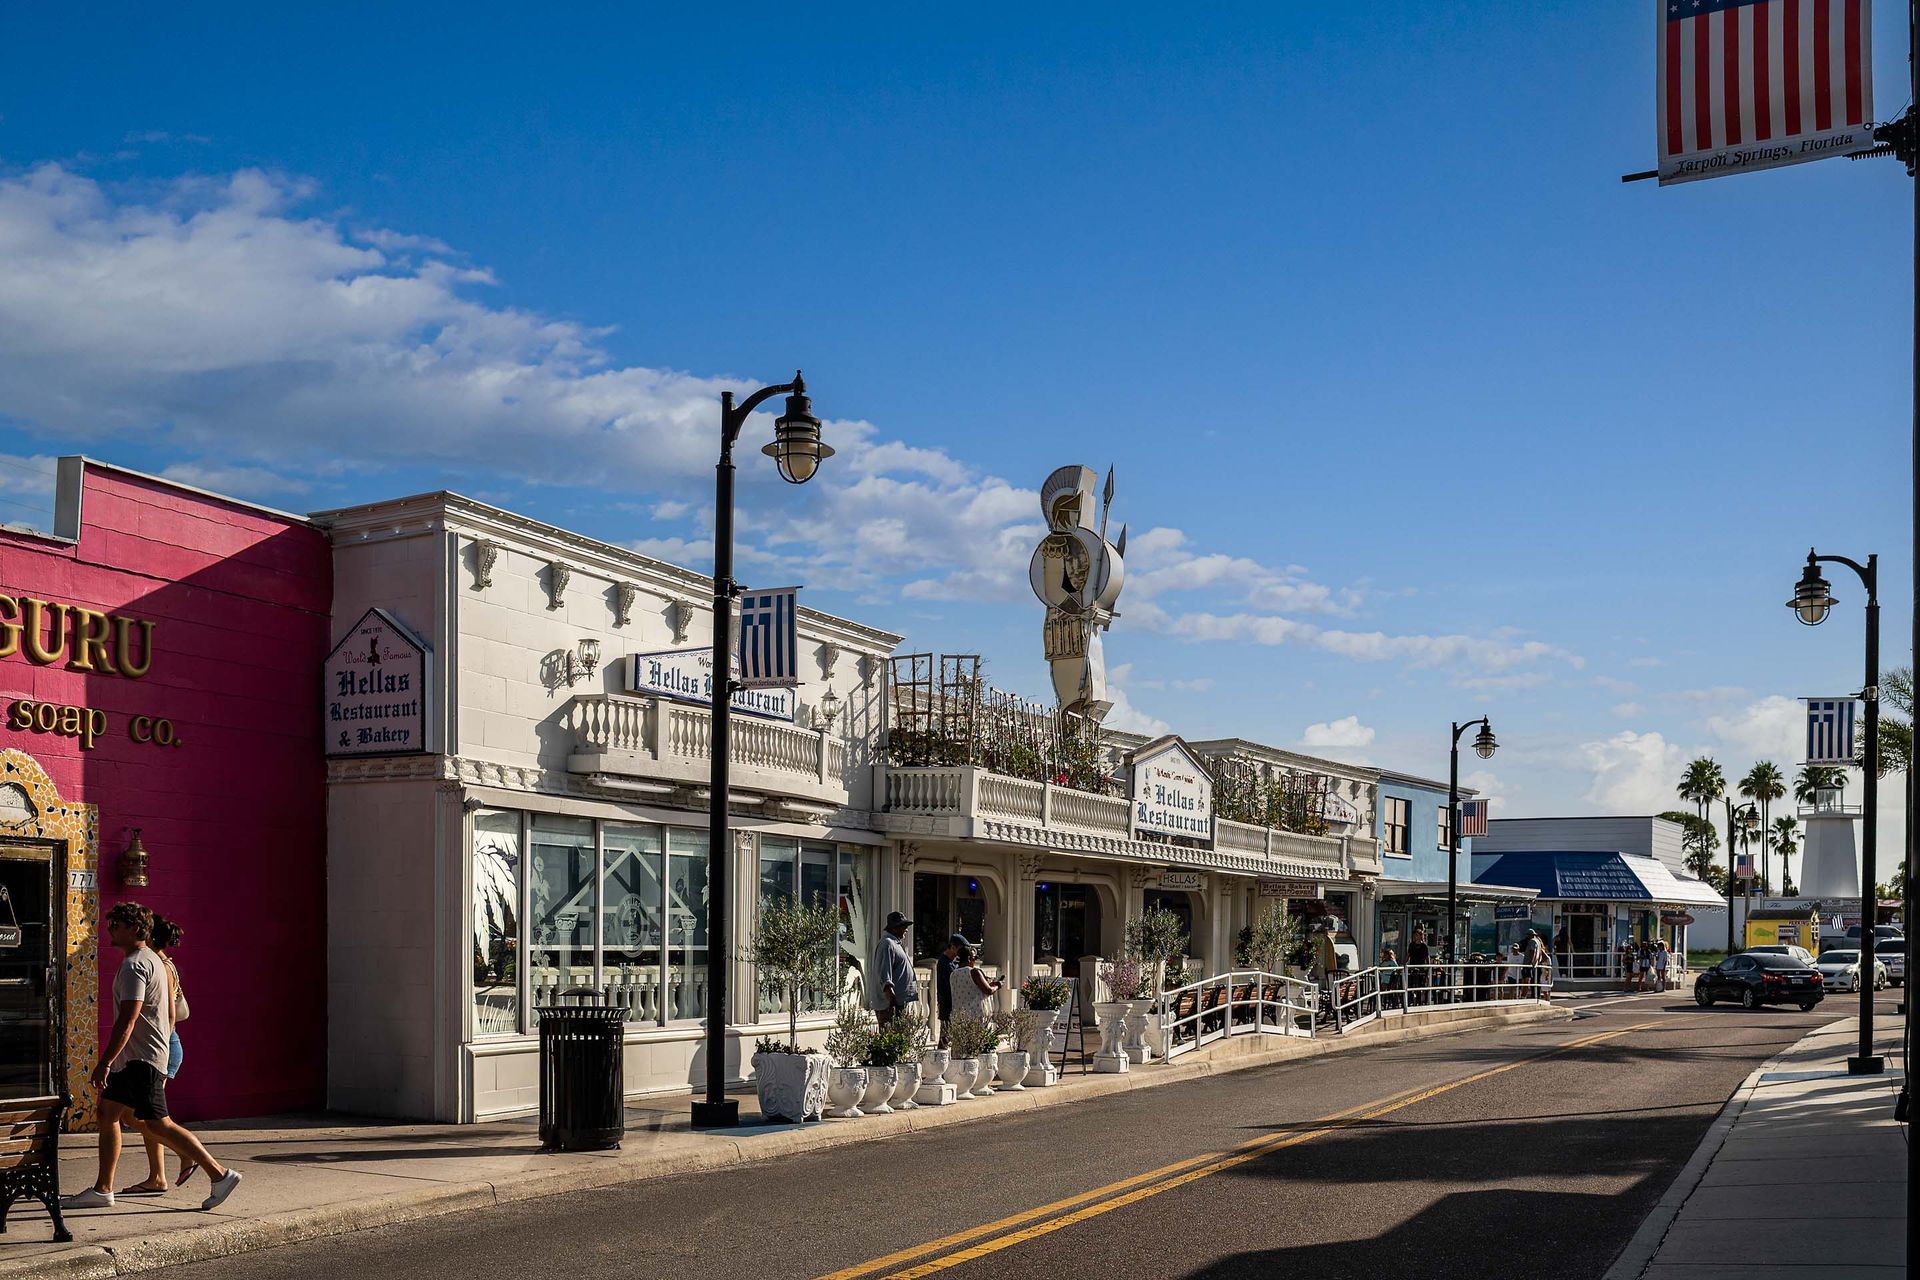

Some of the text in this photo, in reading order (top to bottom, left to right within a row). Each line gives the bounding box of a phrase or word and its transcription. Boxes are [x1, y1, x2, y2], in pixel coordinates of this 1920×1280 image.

[1678, 132, 1854, 173] Tarpon Springs, Florida
[0, 594, 157, 679] GURU
[342, 646, 412, 665] World Famous
[335, 668, 411, 698] Hellas
[648, 659, 699, 695] Hellas
[15, 700, 183, 750] soap co.
[329, 698, 418, 722] Restaurant
[338, 726, 411, 748] & Bakery
[1155, 784, 1195, 811] Hellas
[1137, 801, 1209, 834] Restaurant
[71, 873, 93, 887] 777
